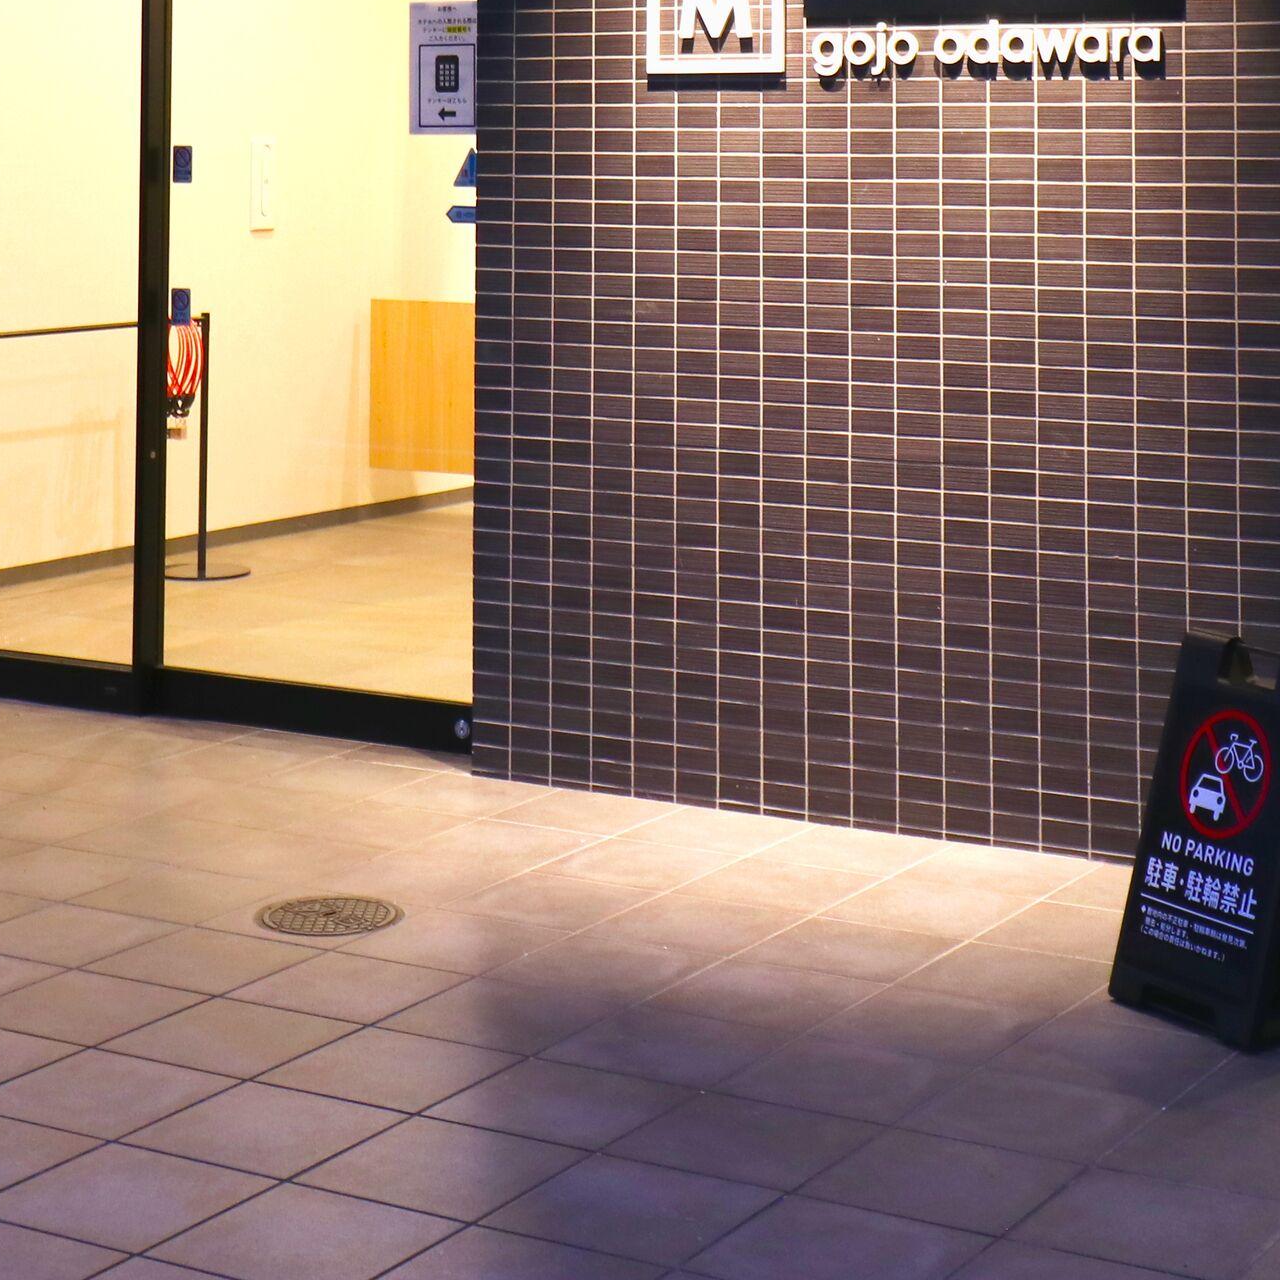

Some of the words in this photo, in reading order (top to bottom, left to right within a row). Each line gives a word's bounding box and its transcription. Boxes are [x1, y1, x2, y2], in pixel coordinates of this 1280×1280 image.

[811, 22, 919, 76] gojo
[933, 19, 1163, 65] odawara
[1161, 831, 1182, 853] NO
[1185, 839, 1254, 877] PARKING
[1144, 856, 1258, 920] 駐車・駐輪禁止
